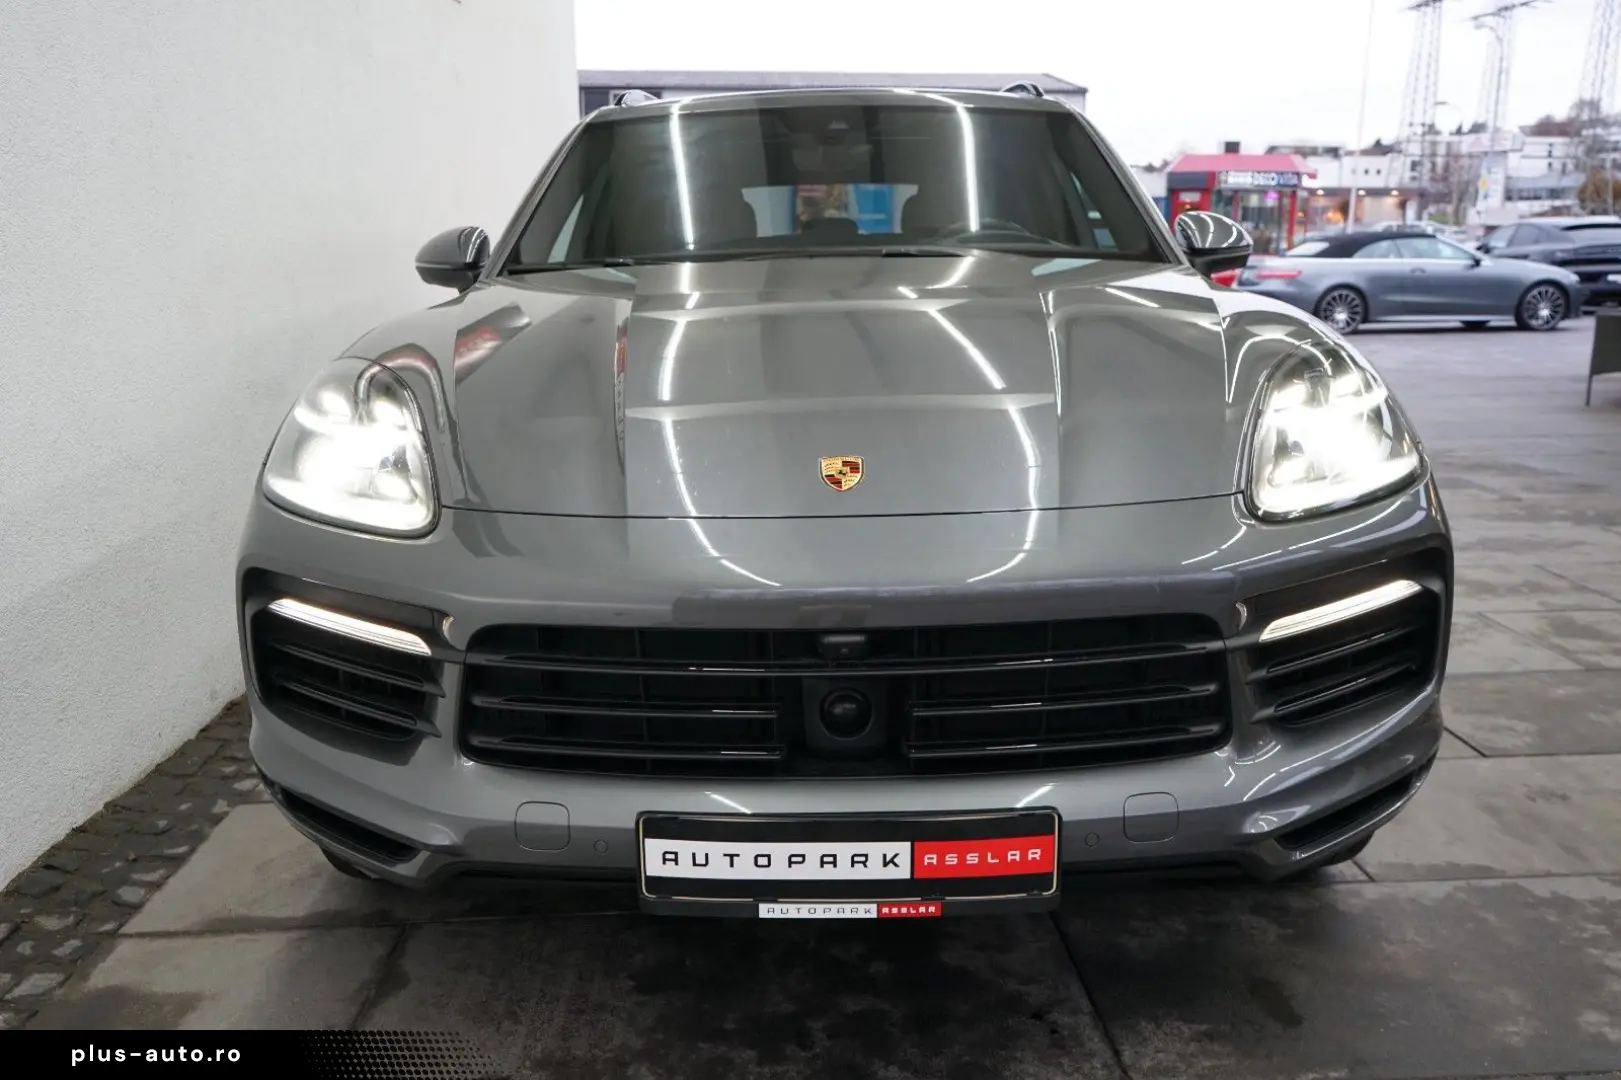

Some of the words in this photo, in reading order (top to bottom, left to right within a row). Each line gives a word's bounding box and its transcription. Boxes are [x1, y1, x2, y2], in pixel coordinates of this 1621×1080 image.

[661, 850, 900, 869] AUTOPARK
[924, 848, 1041, 866] ASSLAR
[766, 906, 873, 916] AUTOPARK
[881, 905, 936, 915] ASSLAR
